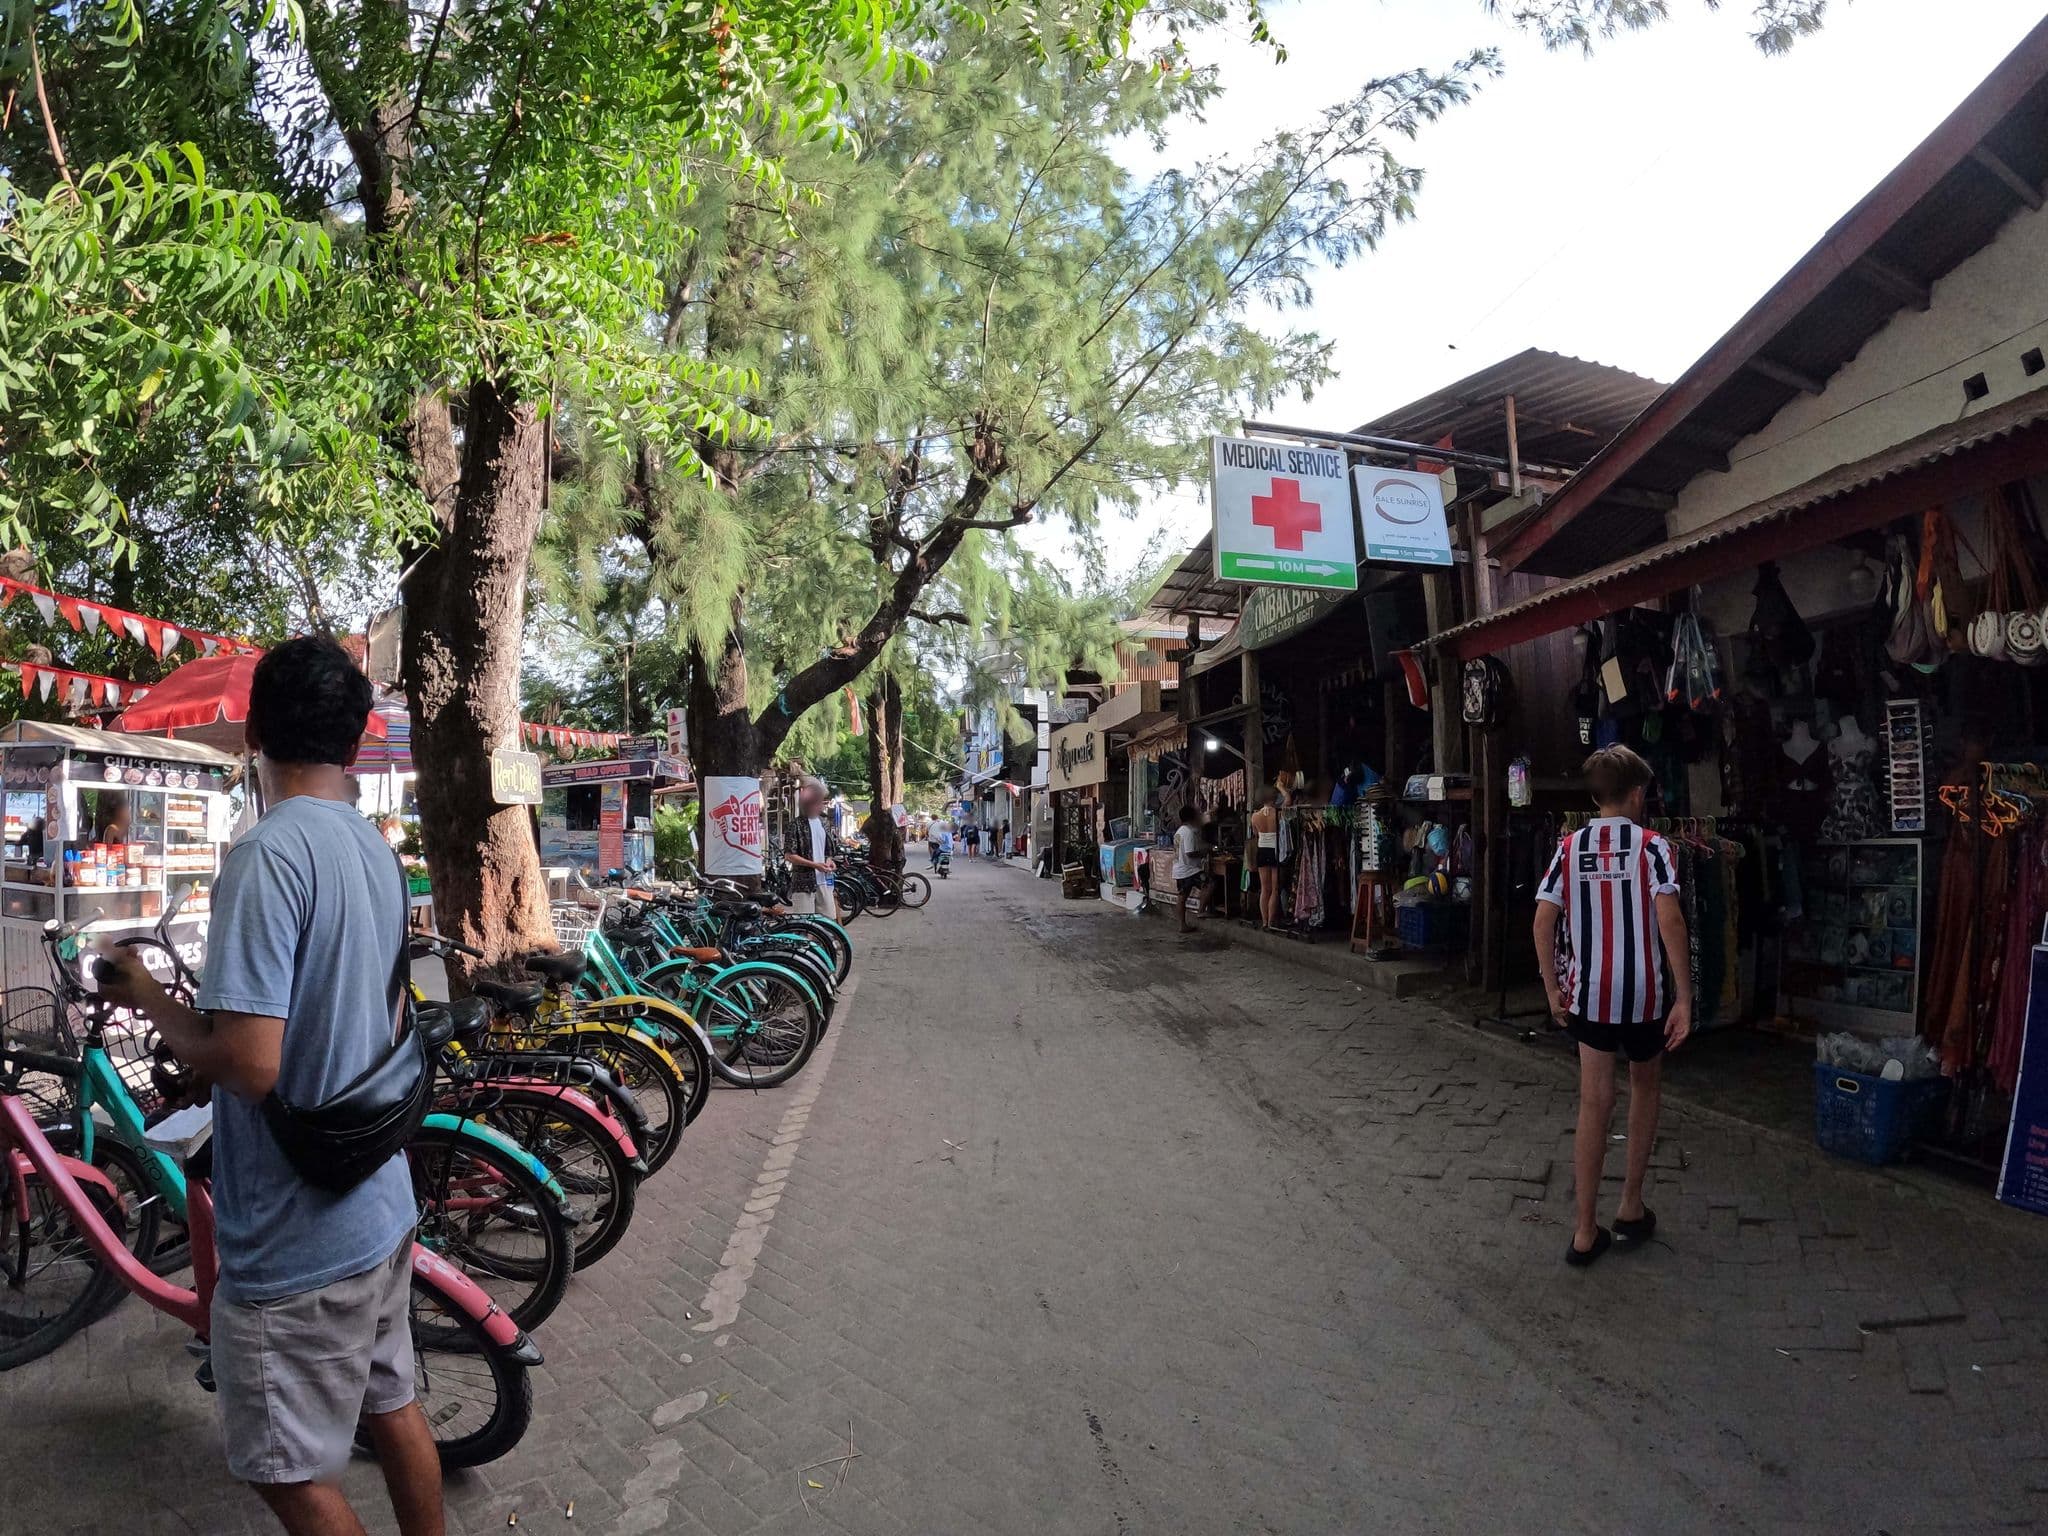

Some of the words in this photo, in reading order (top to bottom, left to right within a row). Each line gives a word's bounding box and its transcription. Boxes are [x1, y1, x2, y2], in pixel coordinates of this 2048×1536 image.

[1222, 442, 1286, 473] MEDICAL
[1287, 449, 1342, 479] SERVICE
[1375, 495, 1396, 505] BALE
[1277, 560, 1304, 574] 10M
[103, 755, 147, 770] GILI'S
[494, 757, 517, 793] Rent
[517, 760, 538, 796] Bike
[1579, 851, 1630, 872] BTT
